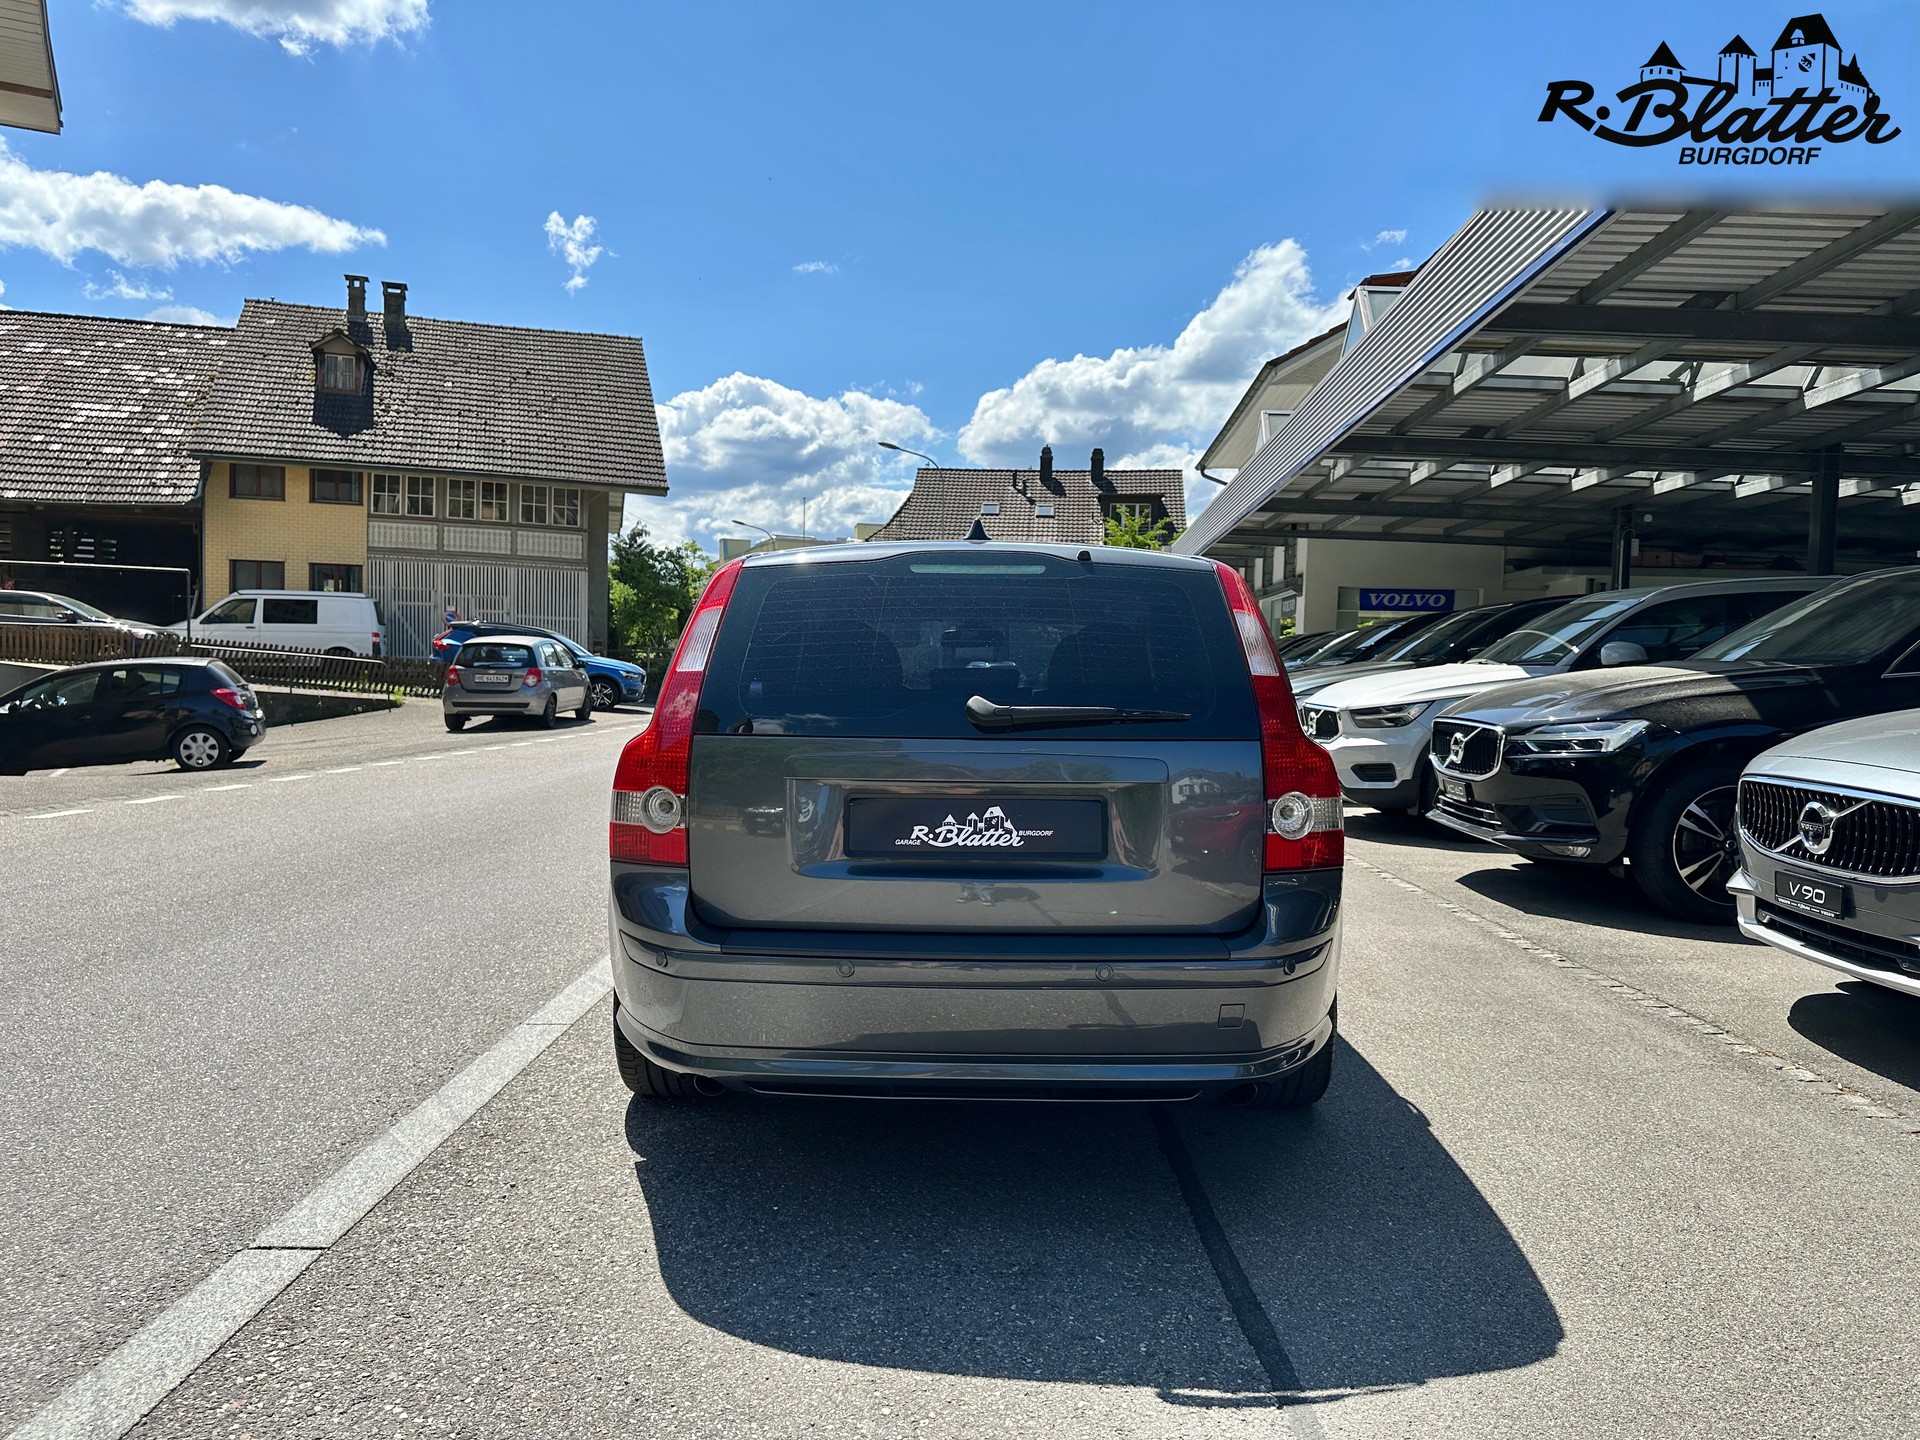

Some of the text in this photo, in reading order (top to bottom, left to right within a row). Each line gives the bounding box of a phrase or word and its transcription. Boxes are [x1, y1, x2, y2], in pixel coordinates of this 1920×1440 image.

[1368, 593, 1446, 607] VOLVO
[1800, 822, 1823, 832] VOLVO
[927, 824, 1025, 847] Blatter
